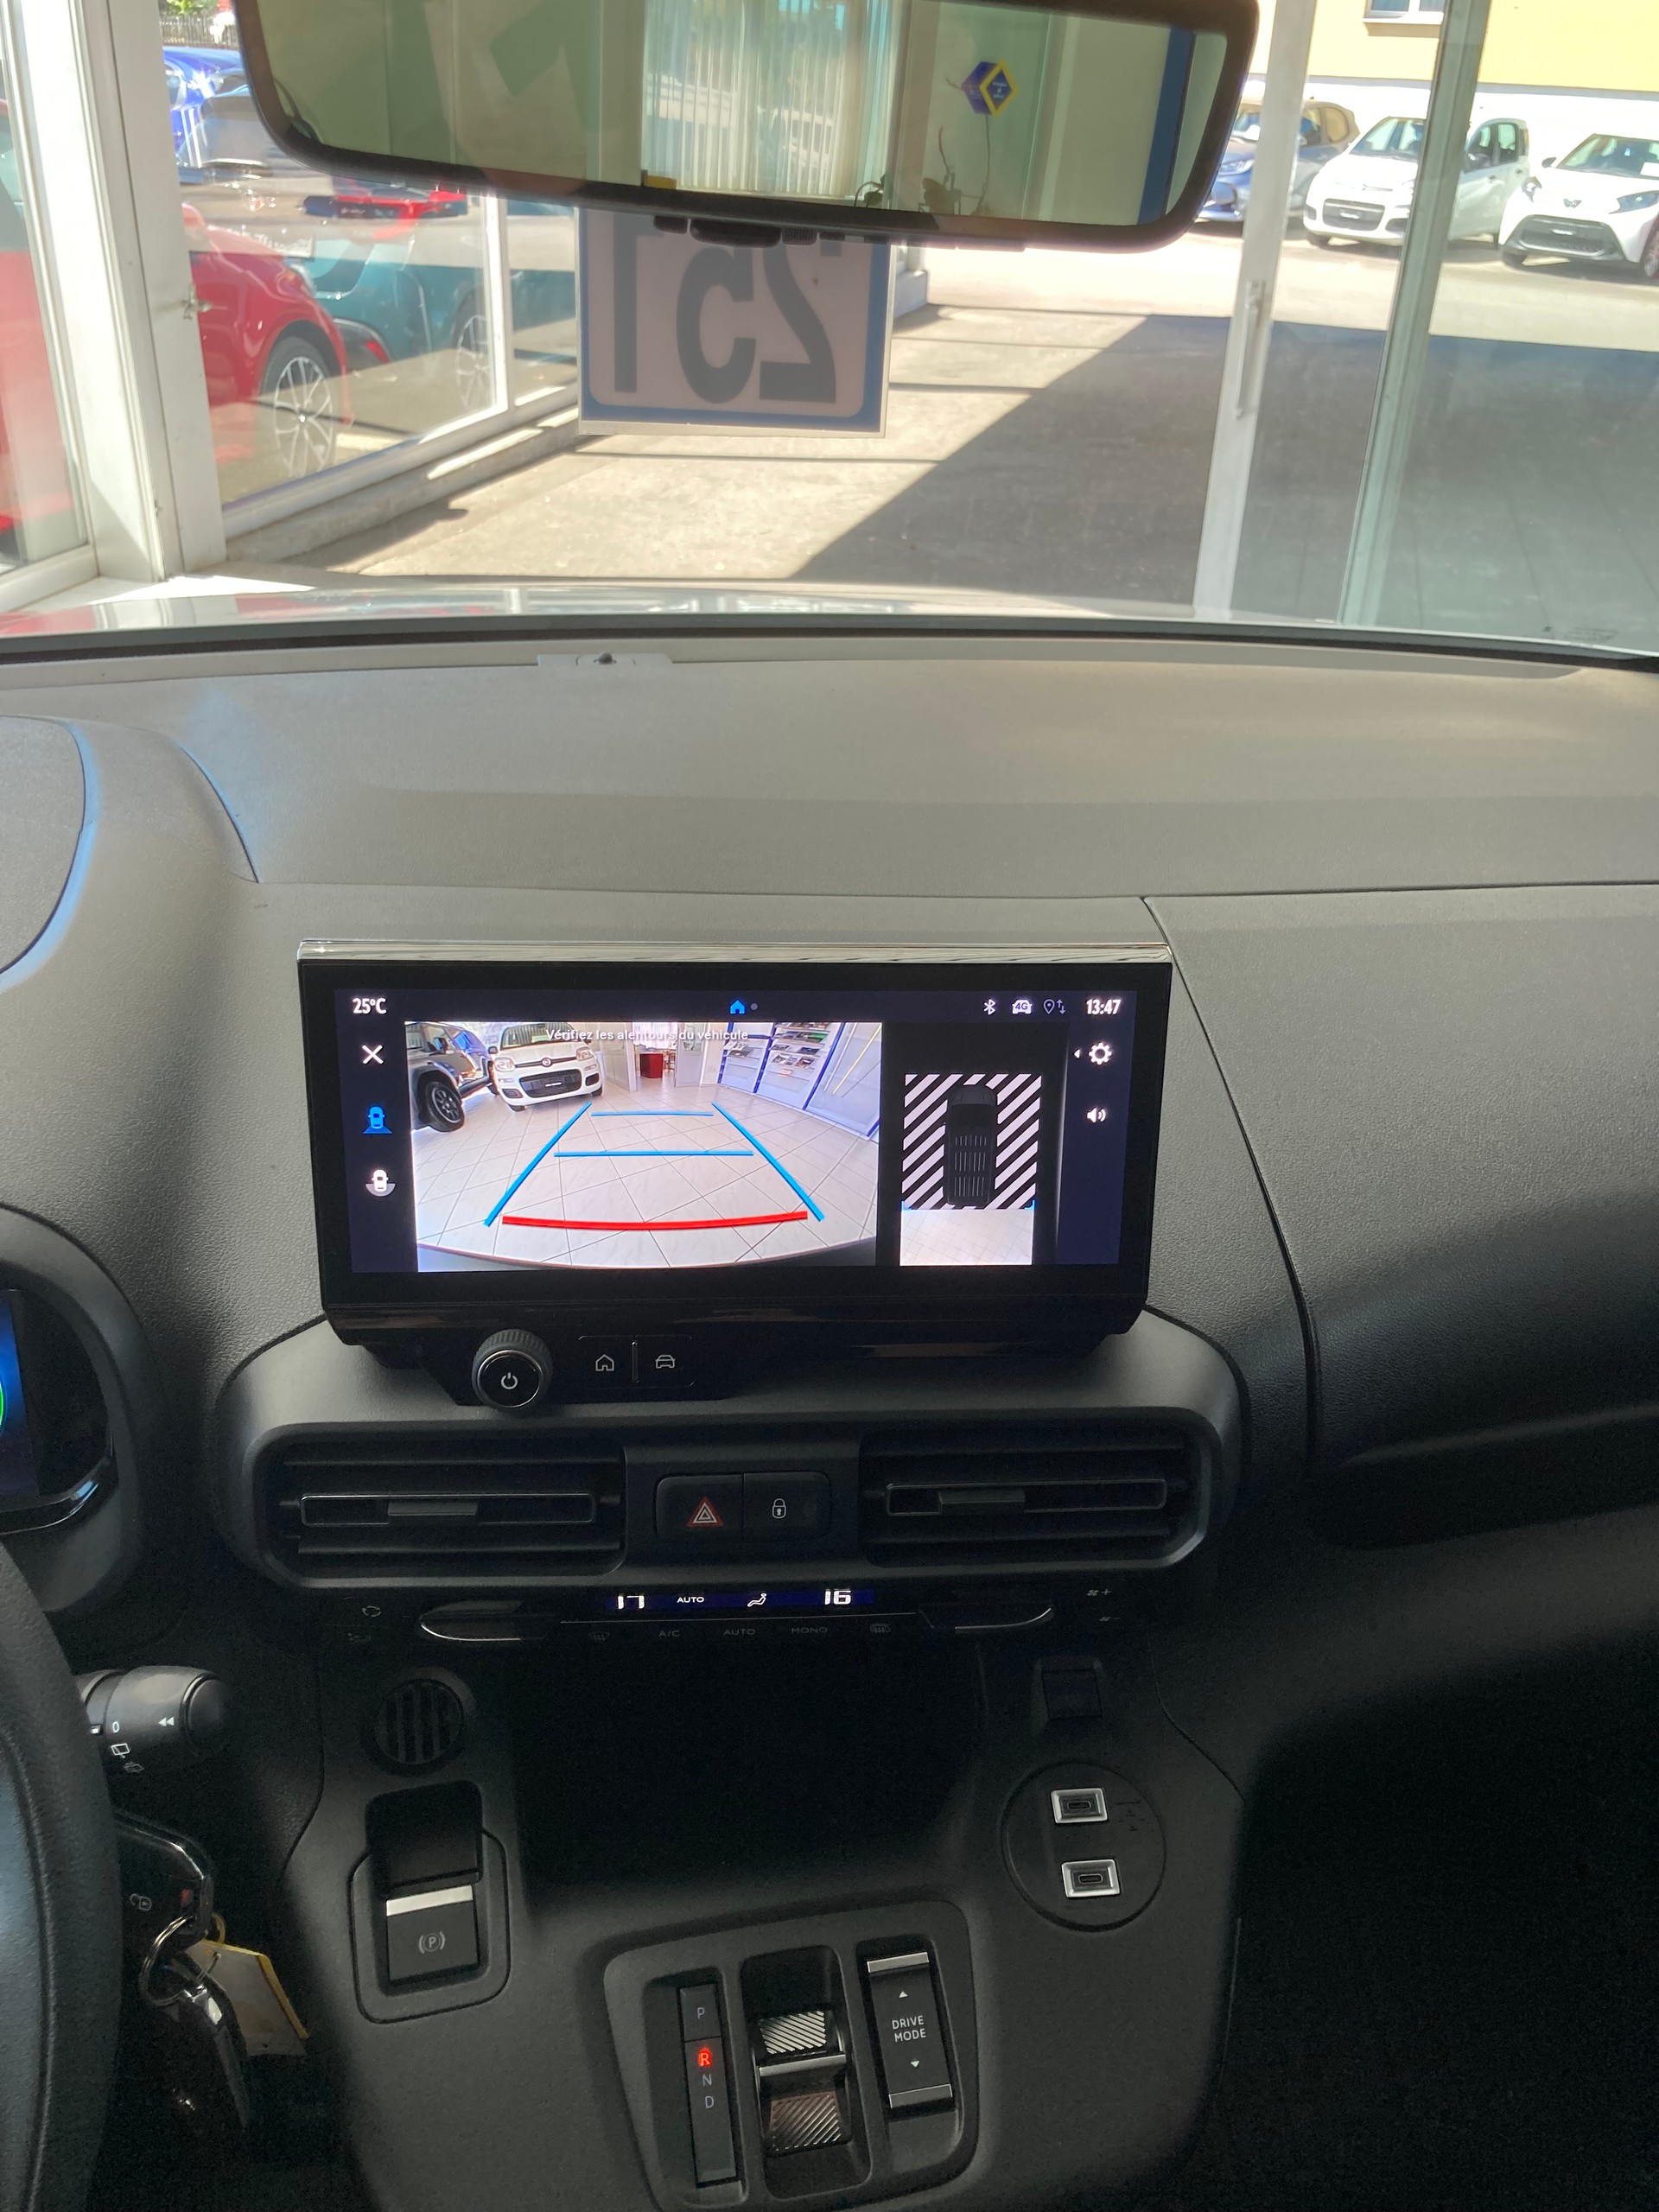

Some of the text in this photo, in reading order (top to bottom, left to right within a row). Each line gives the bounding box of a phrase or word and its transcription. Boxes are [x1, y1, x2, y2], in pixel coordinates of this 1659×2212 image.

[1086, 999, 1122, 1015] 13:47
[546, 1028, 749, 1042] Vérifiez les alentours du véhicule
[824, 1589, 852, 1605] 16
[658, 1626, 828, 1638] A/C AUTO MONO
[696, 2006, 705, 2019] P
[892, 2015, 925, 2030] DRIVE
[893, 2028, 927, 2043] MODE
[700, 2051, 711, 2067] R
[702, 2074, 713, 2087] N
[704, 2095, 715, 2109] D
